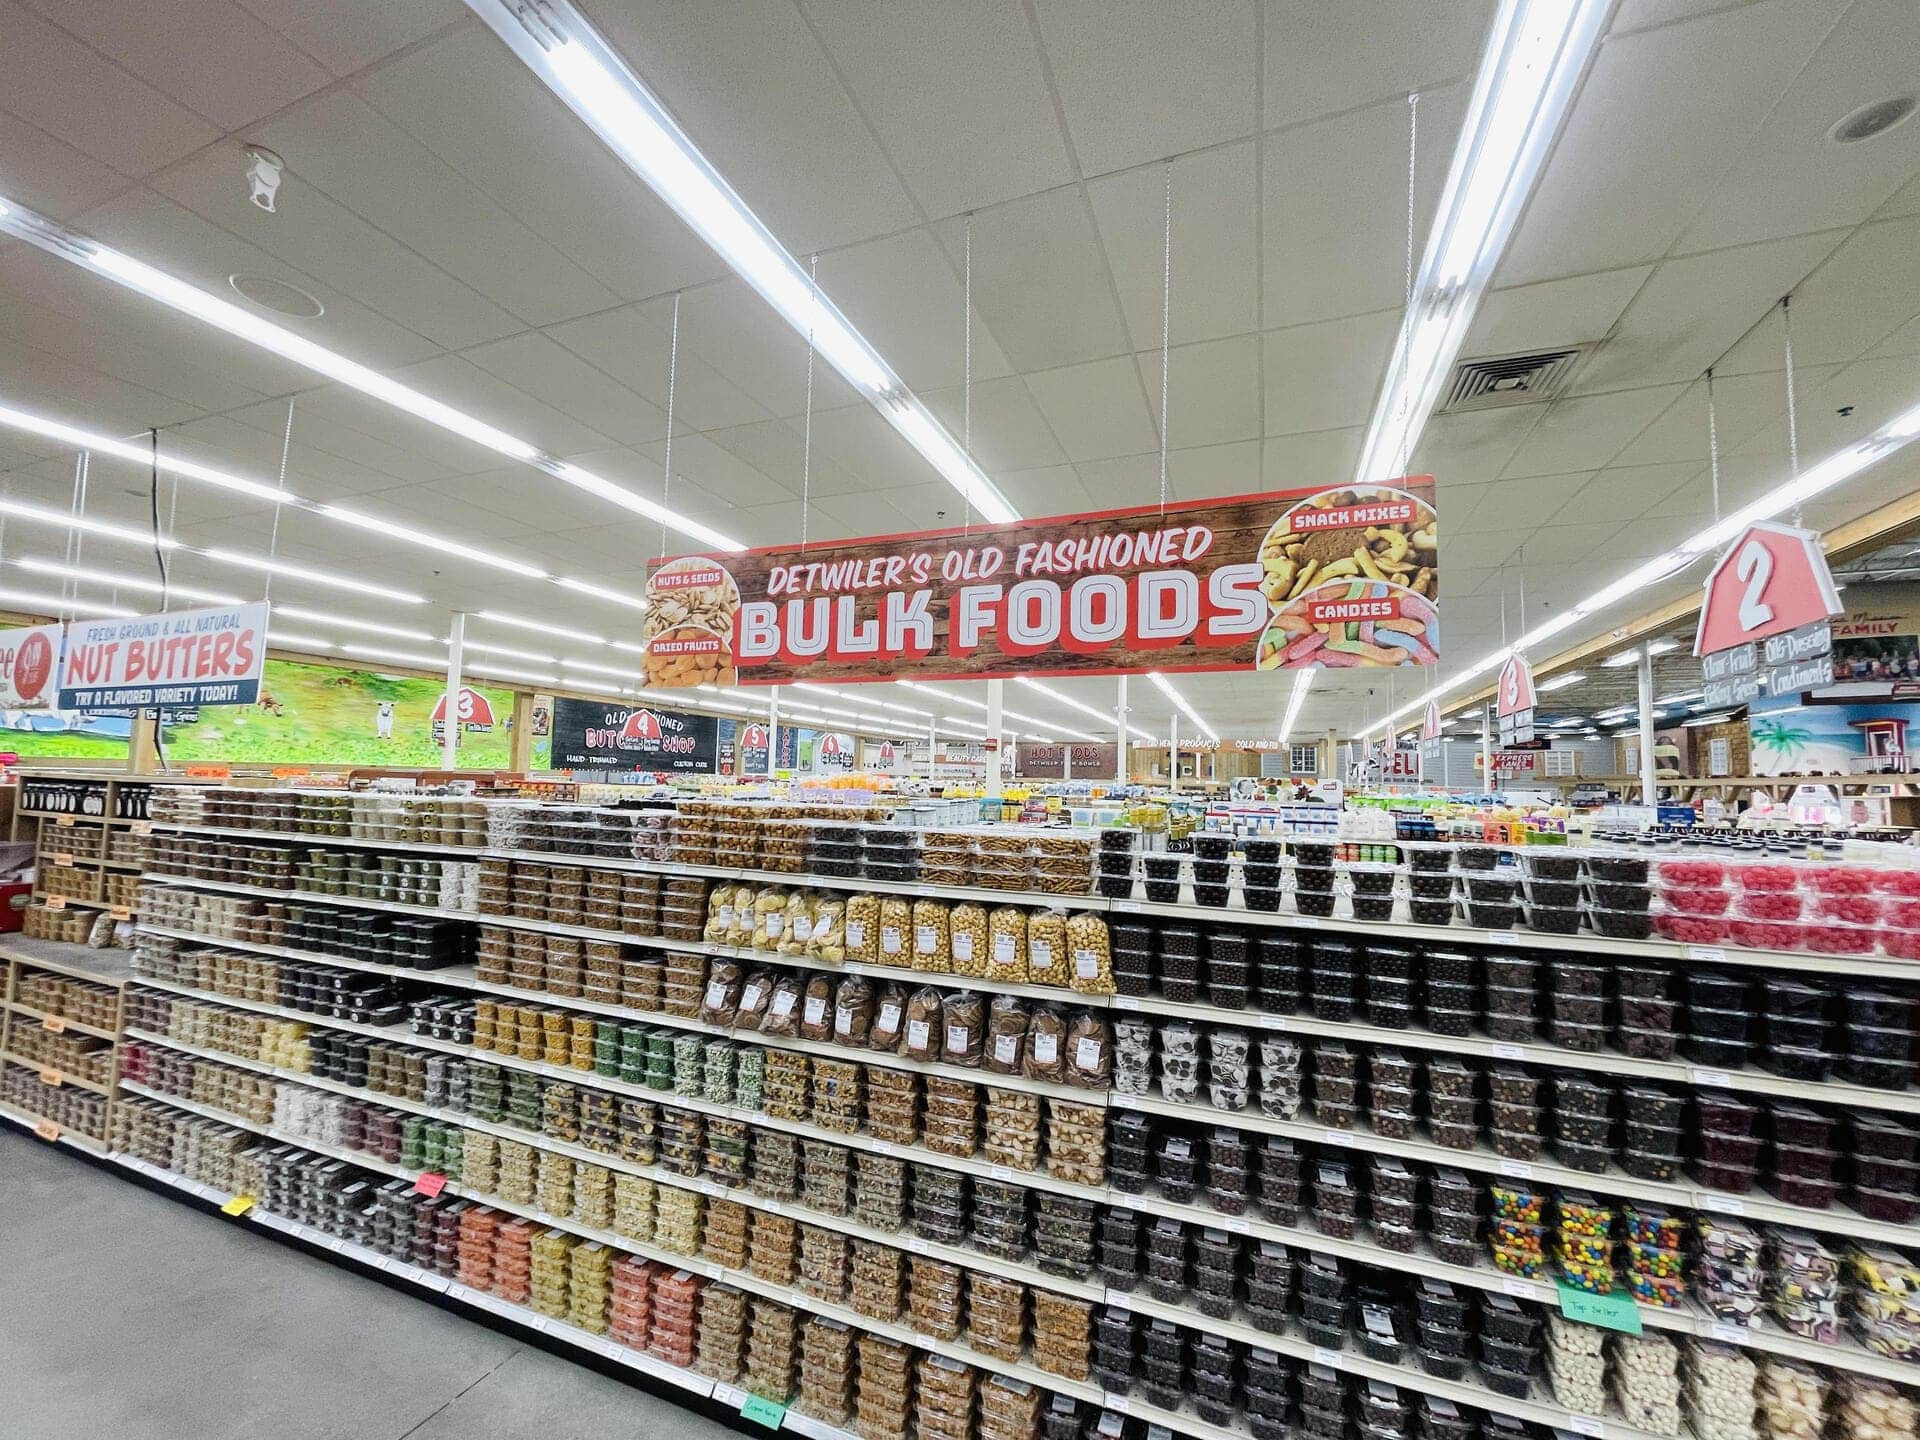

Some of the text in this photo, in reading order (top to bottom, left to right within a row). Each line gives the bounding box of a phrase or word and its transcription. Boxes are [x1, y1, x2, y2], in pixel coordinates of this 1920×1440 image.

[1295, 504, 1411, 528] SNACK MIXES
[767, 526, 1213, 596] DETWILER'S OLD FASHIONED
[658, 572, 721, 587] NUTS & SEEDS
[1737, 540, 1775, 632] 2
[739, 563, 1269, 658] BULK FOODS
[1314, 602, 1392, 619] CANDIES
[86, 613, 241, 643] FRESH GROUND & ALL NATURAL
[66, 641, 120, 686] NUT
[124, 628, 255, 683] BUTTERS
[653, 640, 719, 653] DRIED FRUITS
[75, 684, 238, 706] TRY A FLAVORED VARIETY TODAY!
[1507, 661, 1519, 707] 3
[457, 691, 475, 719] 3
[605, 711, 627, 726] OLD
[637, 714, 649, 736] 4
[585, 727, 627, 750] BUTC
[662, 734, 696, 753] SHOP
[751, 726, 760, 745] 5
[829, 736, 834, 752] 6
[1031, 746, 1053, 759] HOT
